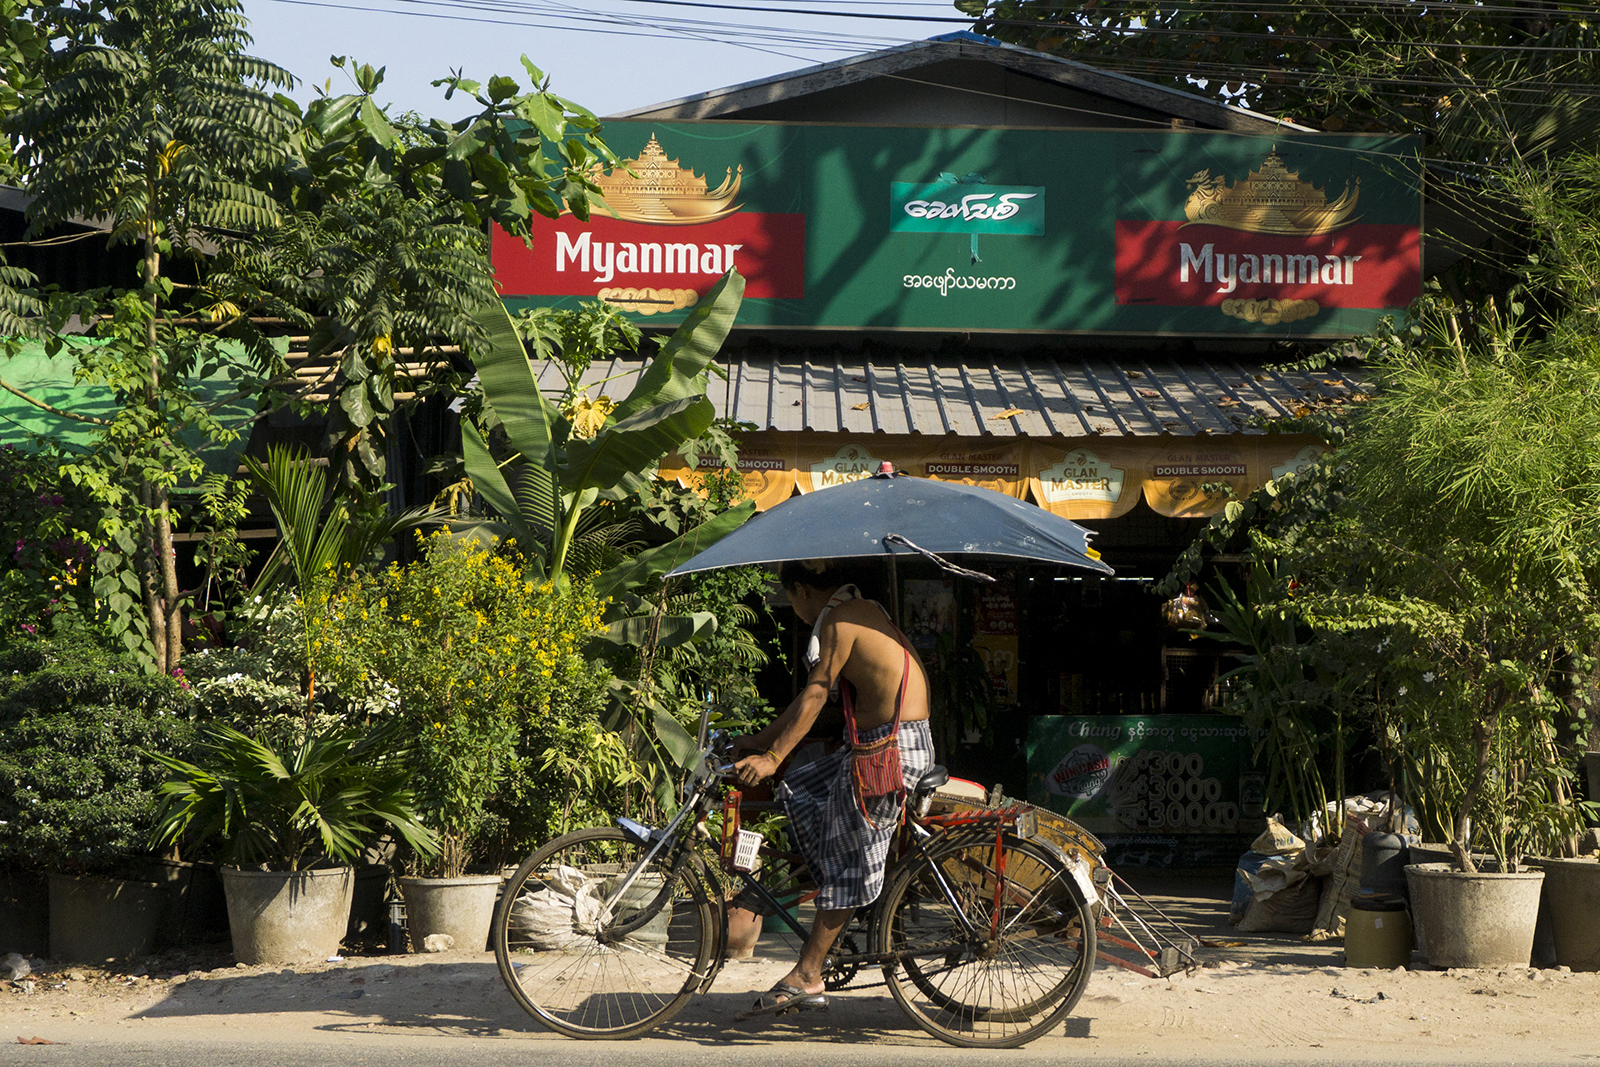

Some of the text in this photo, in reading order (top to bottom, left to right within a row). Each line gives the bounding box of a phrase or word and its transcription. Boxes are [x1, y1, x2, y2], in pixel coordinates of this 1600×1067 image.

[555, 231, 744, 283] Myanmar
[1179, 242, 1363, 294] Myanmar
[903, 267, 1016, 297] အဖျော်ယမကာ
[940, 452, 1003, 461] GLAN MASTER
[1167, 454, 1231, 463] GLAN MASTER
[738, 459, 783, 469] SMOOTH
[834, 462, 869, 473] GLAN
[928, 464, 1017, 474] DOUBLE SMOOTH
[1063, 467, 1098, 478] GLAN
[1156, 466, 1245, 475] DOUBLE SMOOTH
[1068, 721, 1122, 740] Chang
[1053, 757, 1109, 784] WIN CASH
